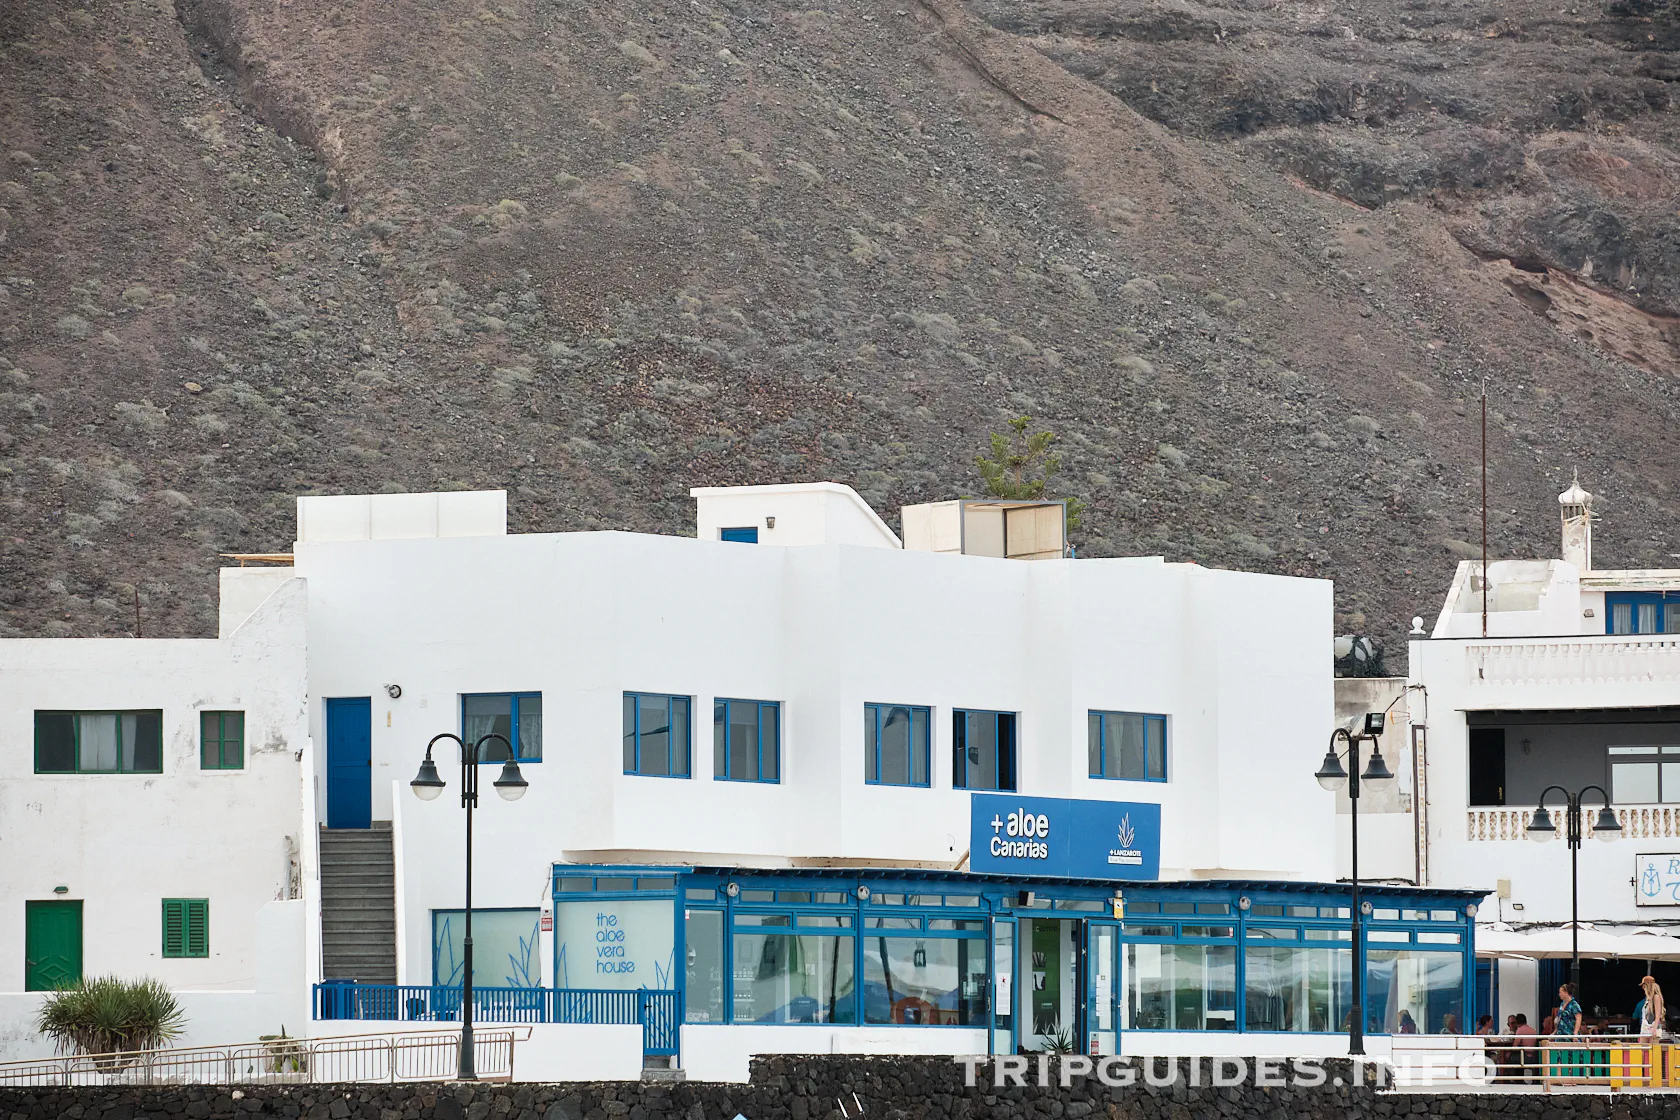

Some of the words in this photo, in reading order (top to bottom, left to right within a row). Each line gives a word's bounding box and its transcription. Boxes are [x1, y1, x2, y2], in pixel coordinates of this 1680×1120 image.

[1007, 808, 1048, 837] aloe
[990, 836, 1048, 860] Canarias
[596, 913, 617, 926] the
[596, 930, 625, 943] aloe
[596, 946, 625, 958] vera
[596, 961, 635, 973] house
